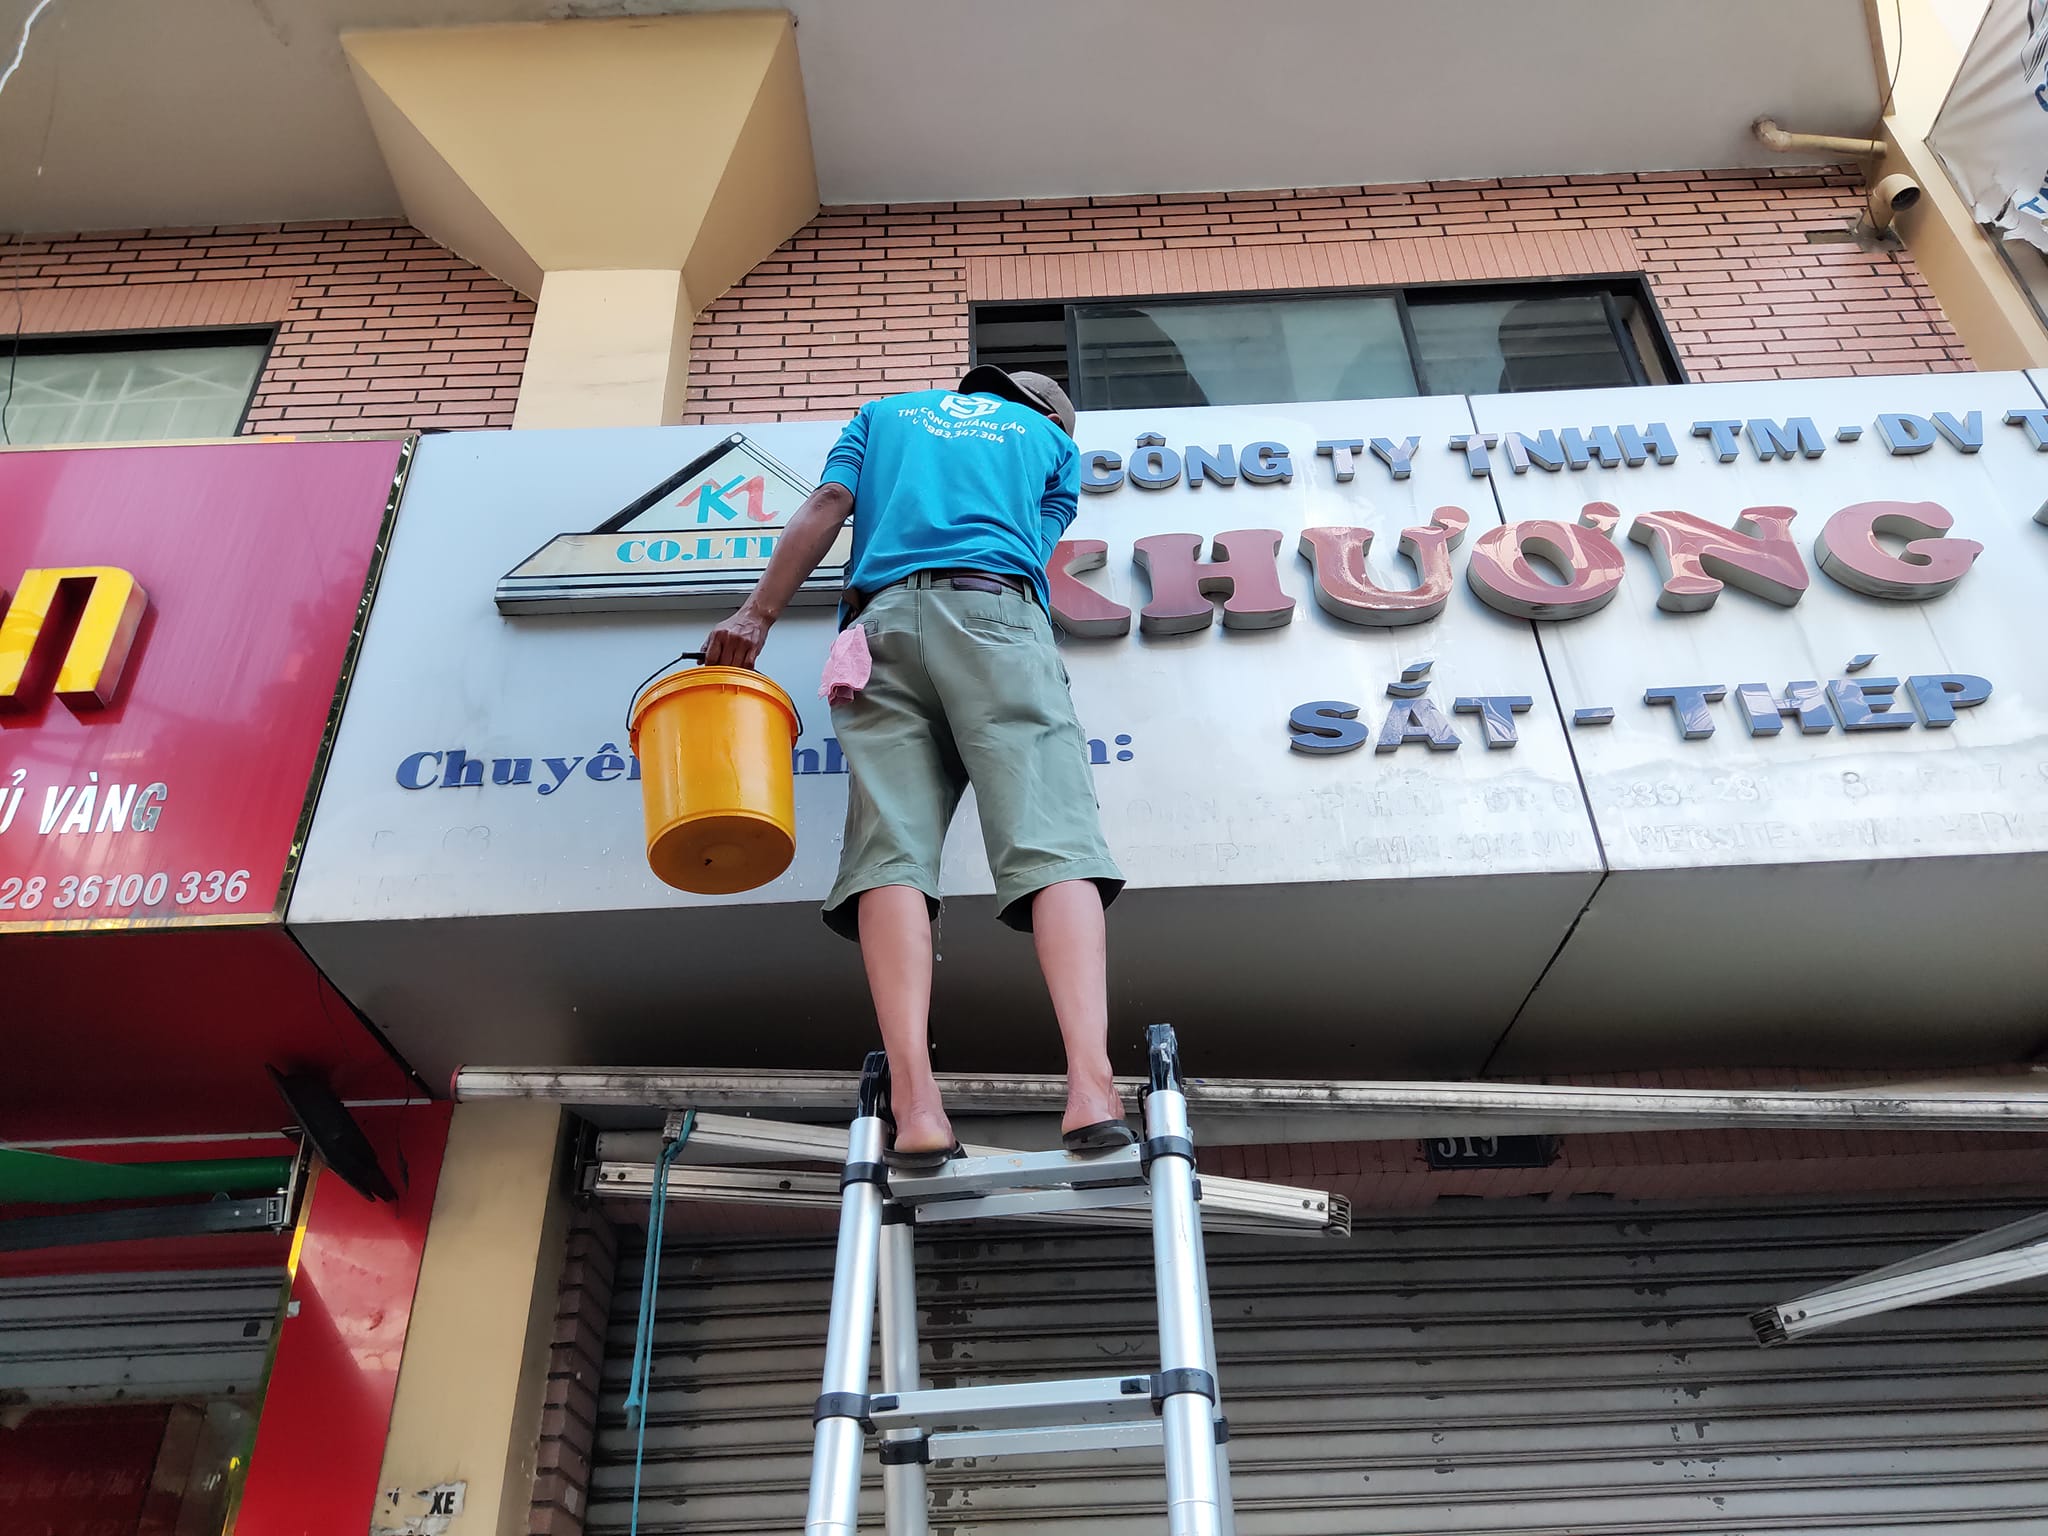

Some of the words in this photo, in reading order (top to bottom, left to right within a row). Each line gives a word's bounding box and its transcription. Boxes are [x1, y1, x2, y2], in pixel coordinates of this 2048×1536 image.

[898, 408, 918, 418] THI
[1080, 431, 1294, 493] CÔNG
[1315, 436, 1422, 482] TY
[1449, 422, 1678, 477] TNHH
[1288, 660, 1534, 755] SẮT
[1643, 653, 1994, 740] THÉP
[38, 771, 168, 835] VÀNG
[53, 873, 168, 909] 36100
[176, 869, 250, 904] 336
[429, 1491, 456, 1515] XE
